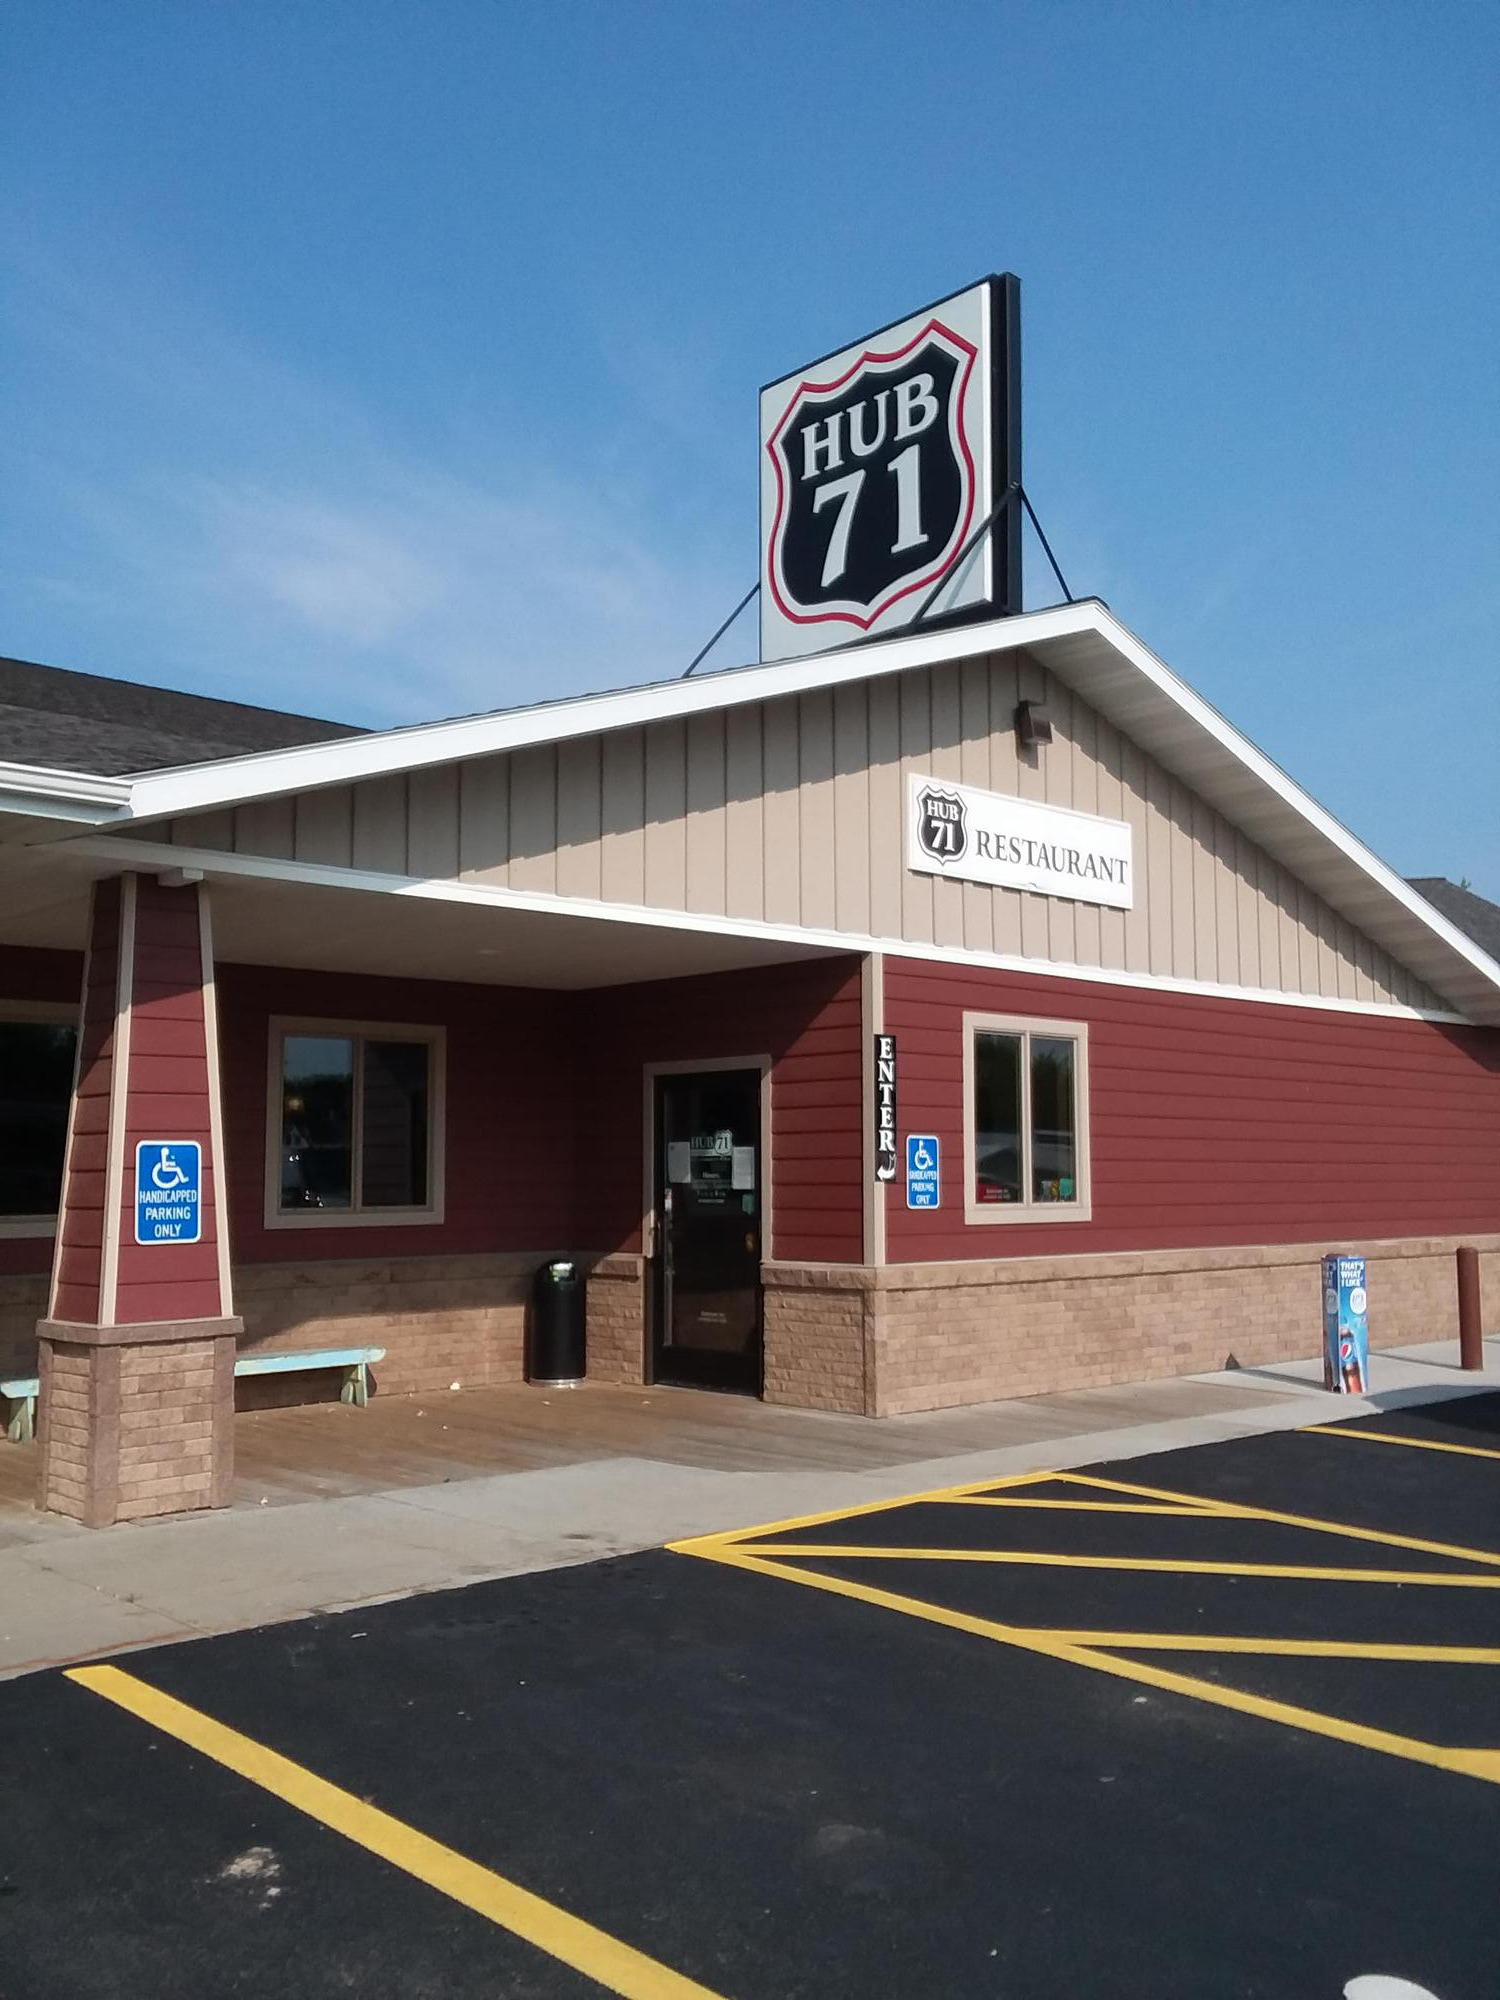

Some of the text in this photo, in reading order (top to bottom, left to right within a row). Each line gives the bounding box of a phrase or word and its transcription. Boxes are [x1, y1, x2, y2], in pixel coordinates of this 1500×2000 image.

[801, 372, 939, 480] HUB
[813, 444, 930, 588] 71
[927, 800, 958, 822] HUB
[930, 820, 956, 852] 71
[975, 829, 1128, 884] RESTAURANT
[878, 1037, 895, 1151] ENTER
[691, 1136, 729, 1150] HUB 71
[139, 1190, 197, 1204] HANDICAPPED
[145, 1206, 191, 1220] PARKING
[154, 1223, 181, 1238] ONLY
[1340, 1271, 1361, 1279] WHAT
[1346, 1279, 1360, 1288] LIKE
